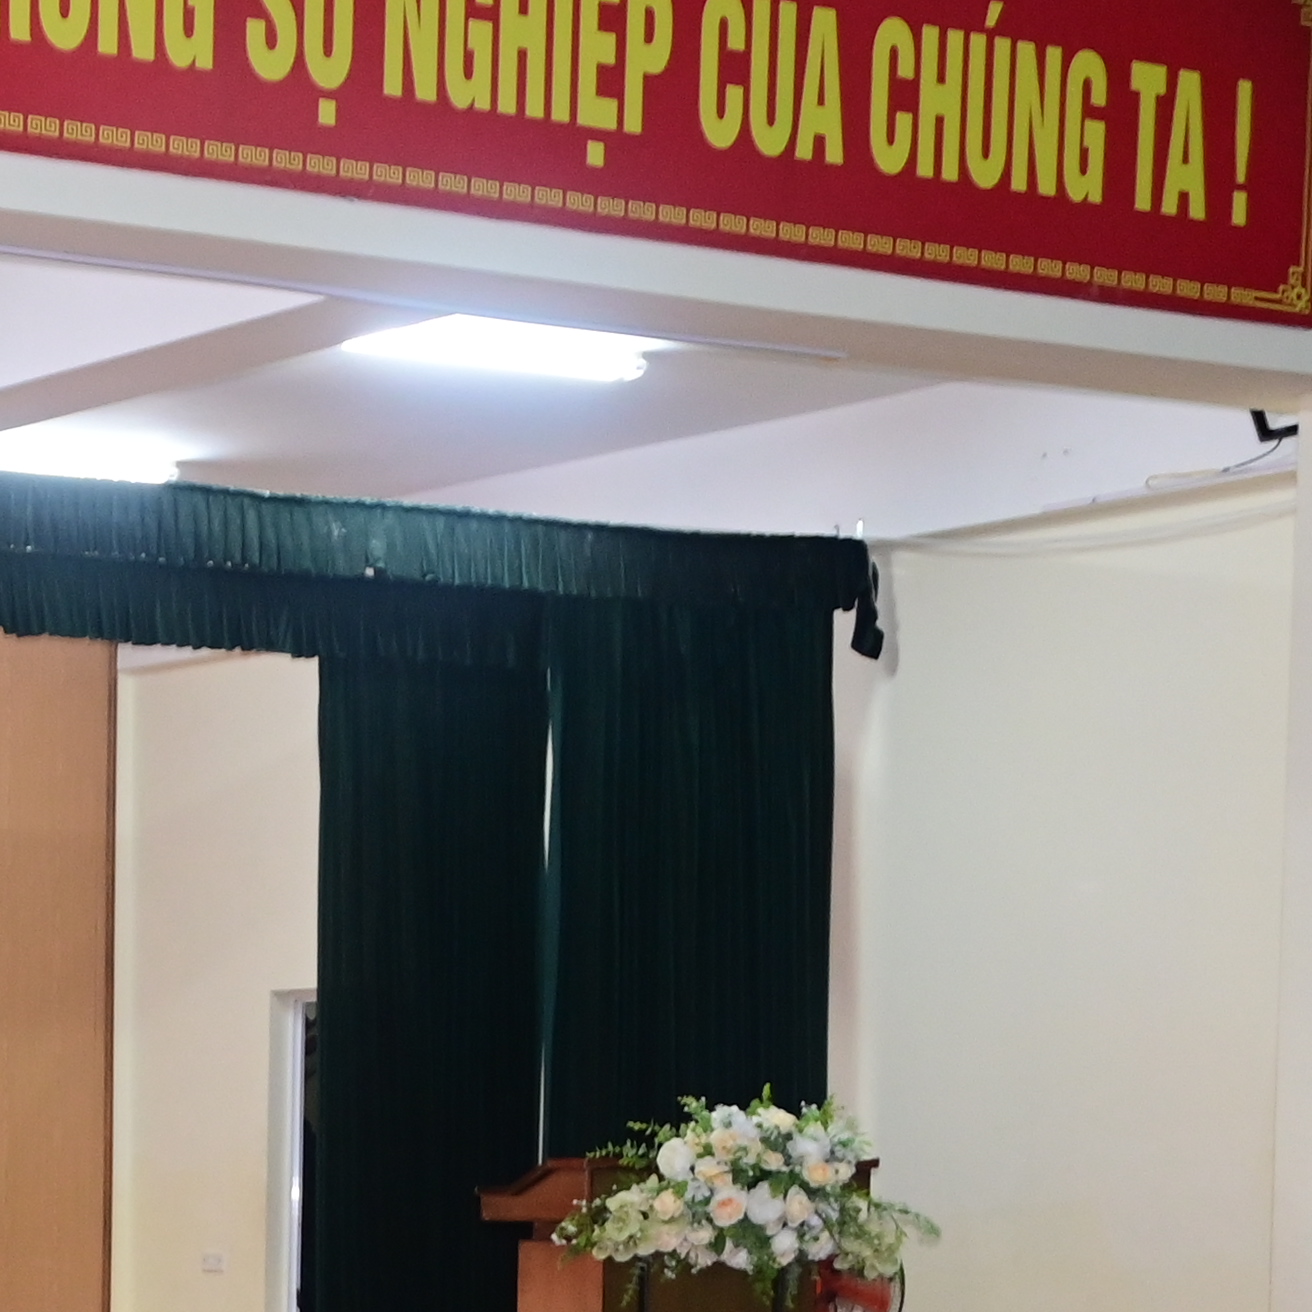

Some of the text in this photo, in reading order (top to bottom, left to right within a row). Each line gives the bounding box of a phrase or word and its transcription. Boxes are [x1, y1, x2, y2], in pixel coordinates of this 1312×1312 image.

[868, 0, 1108, 205] CHÚNG
[1129, 59, 1207, 221] TA
[1231, 78, 1253, 227] !
